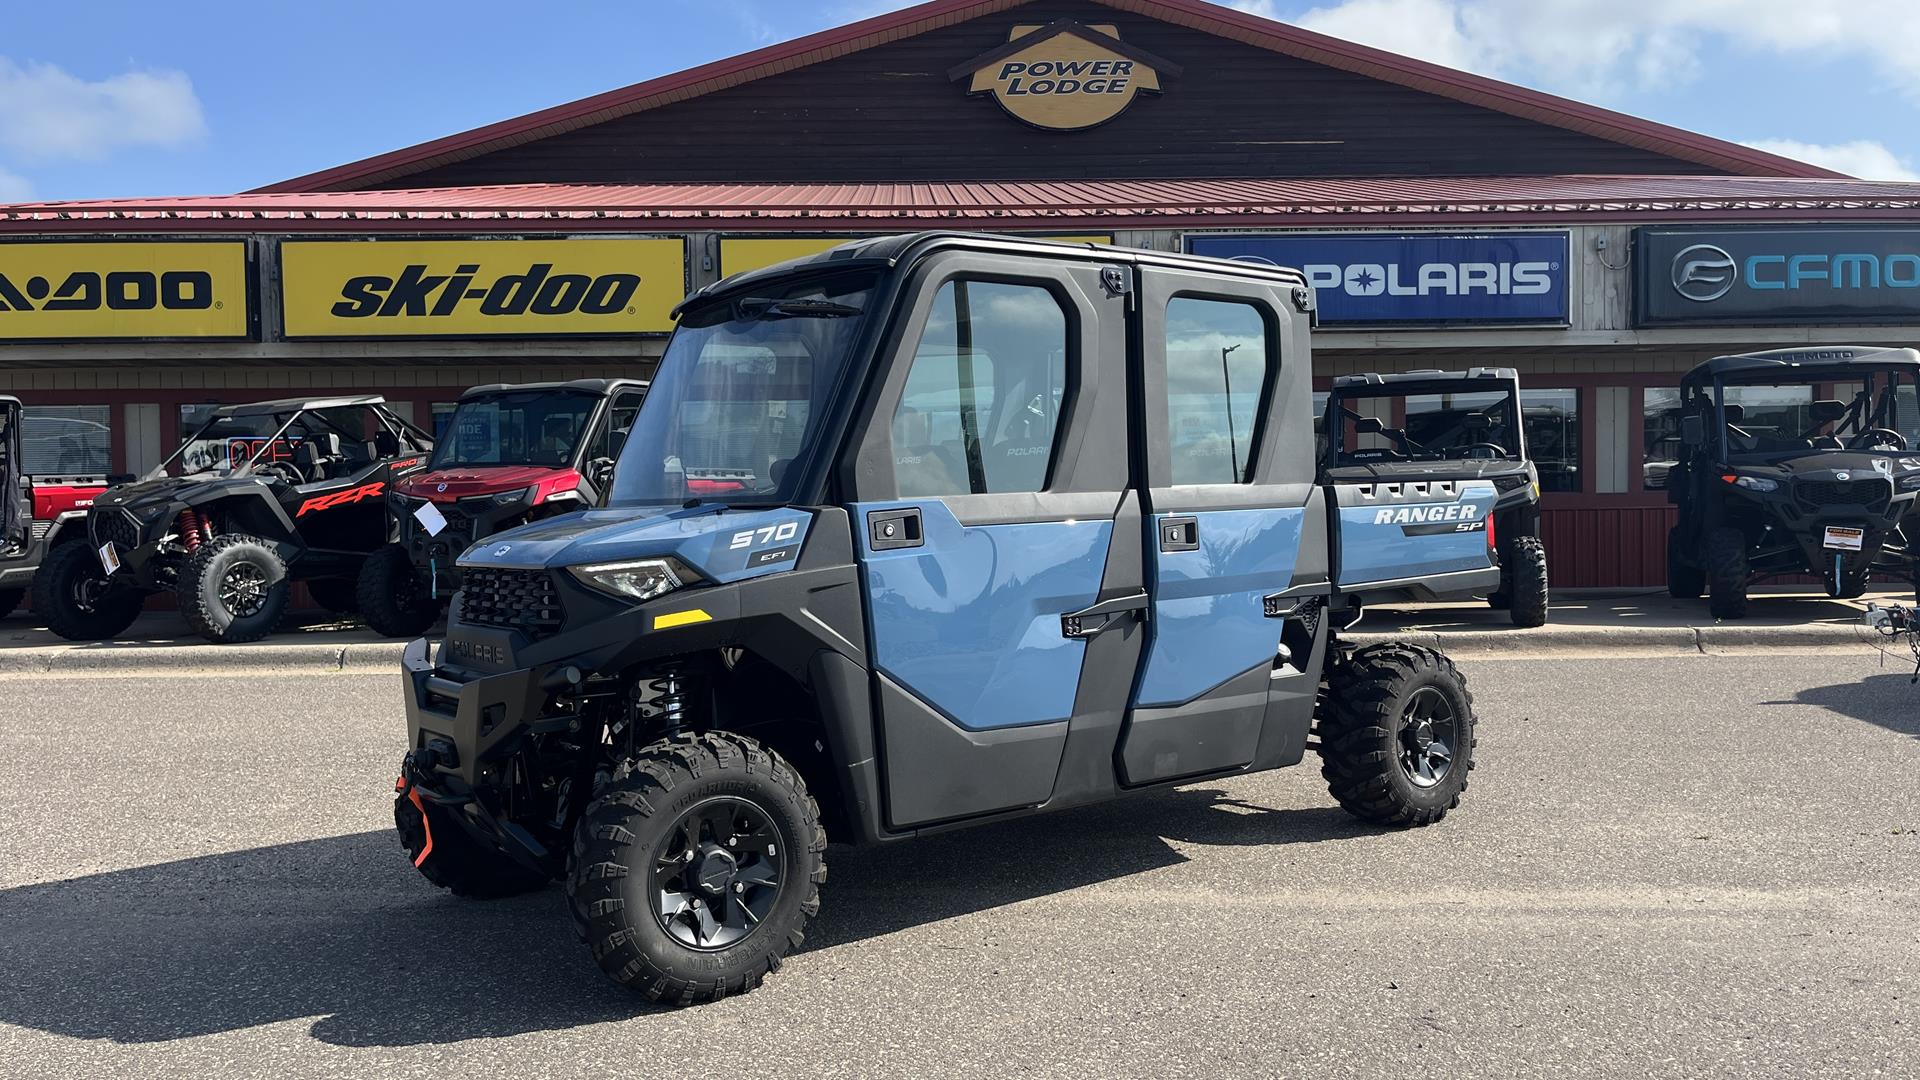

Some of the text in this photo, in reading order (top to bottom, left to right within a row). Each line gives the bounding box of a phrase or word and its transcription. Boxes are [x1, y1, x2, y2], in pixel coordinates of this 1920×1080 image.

[998, 61, 1133, 80] POWER
[1006, 78, 1127, 95] LODGE
[1303, 262, 1551, 296] POLARIS
[330, 263, 641, 317] ski-doo
[296, 482, 385, 518] RZR
[1373, 504, 1477, 525] RANGER
[1455, 521, 1484, 532] SP
[760, 550, 786, 561] EFI
